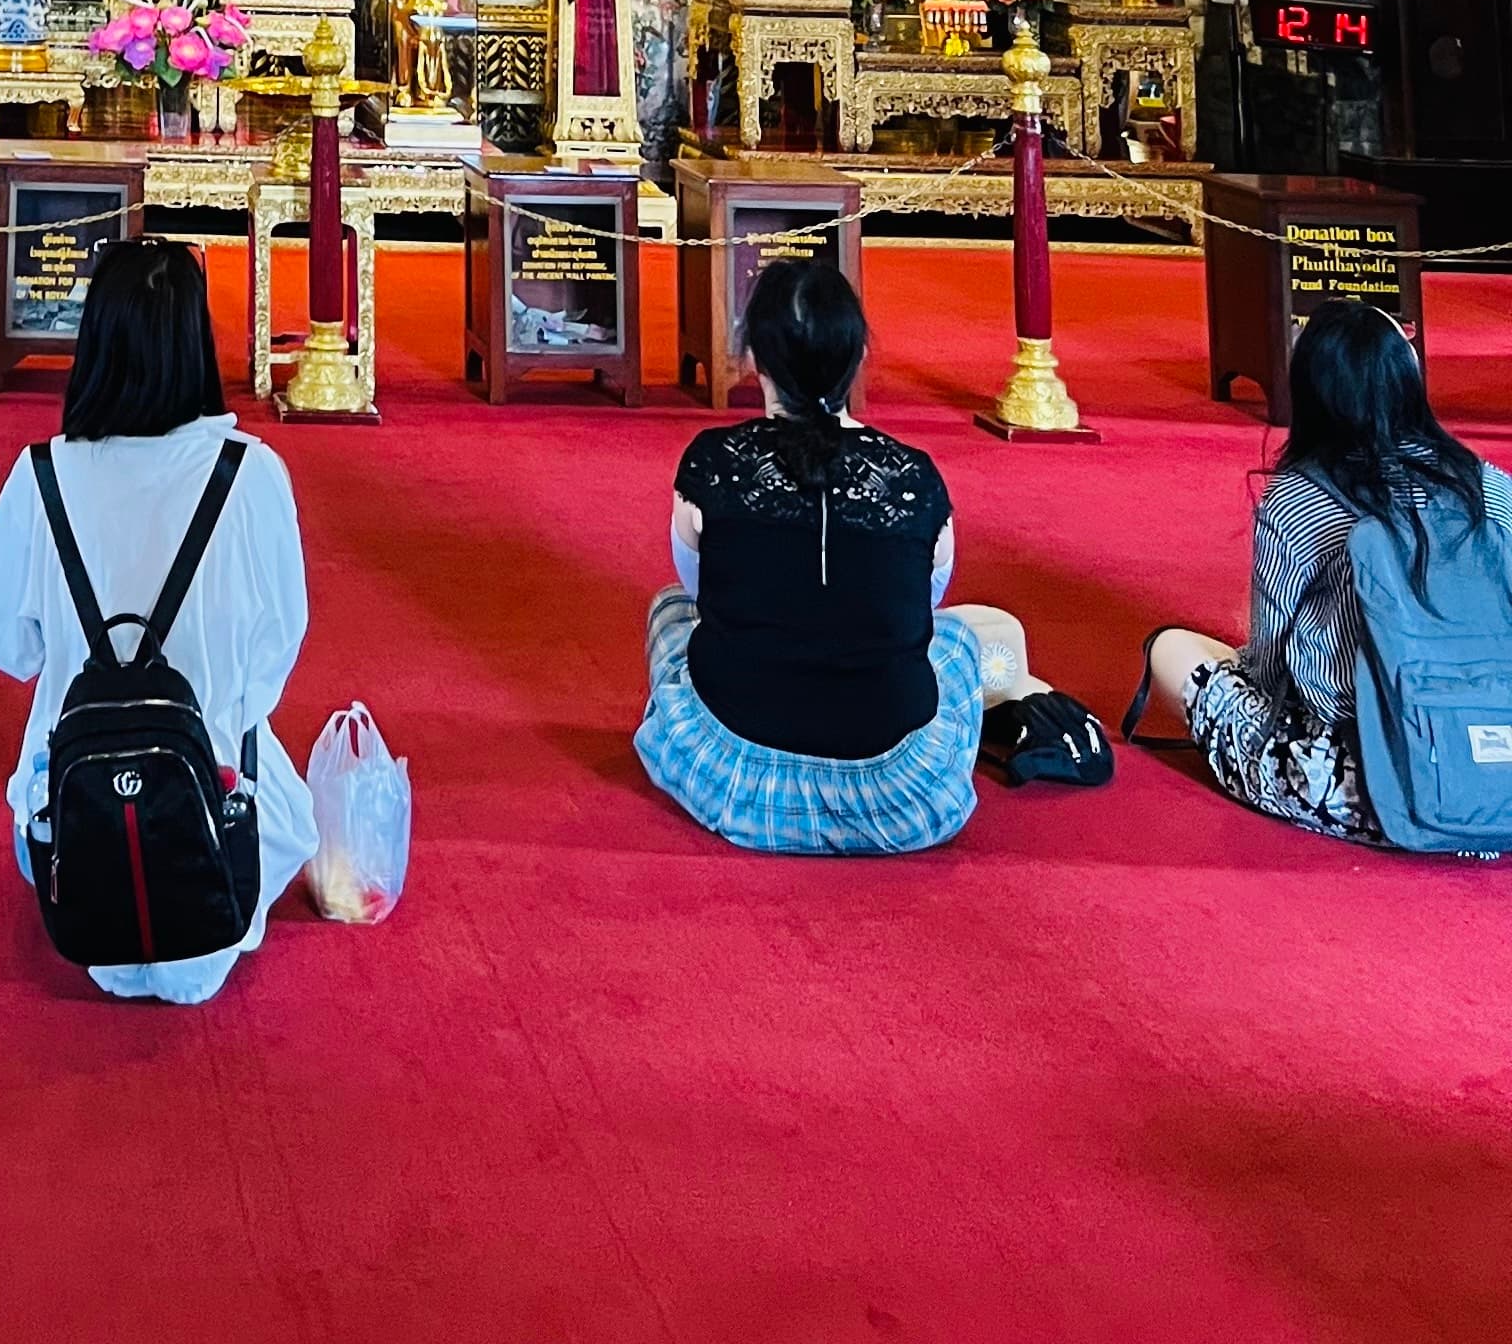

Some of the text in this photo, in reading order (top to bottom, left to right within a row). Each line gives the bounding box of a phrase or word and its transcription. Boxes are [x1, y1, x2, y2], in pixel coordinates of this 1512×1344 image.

[1278, 6, 1367, 45] 12 14
[1286, 224, 1396, 243] Donation box
[1291, 255, 1396, 278] Phutthayodfa
[58, 277, 74, 286] FOR
[1291, 278, 1400, 293] Fund Foundation
